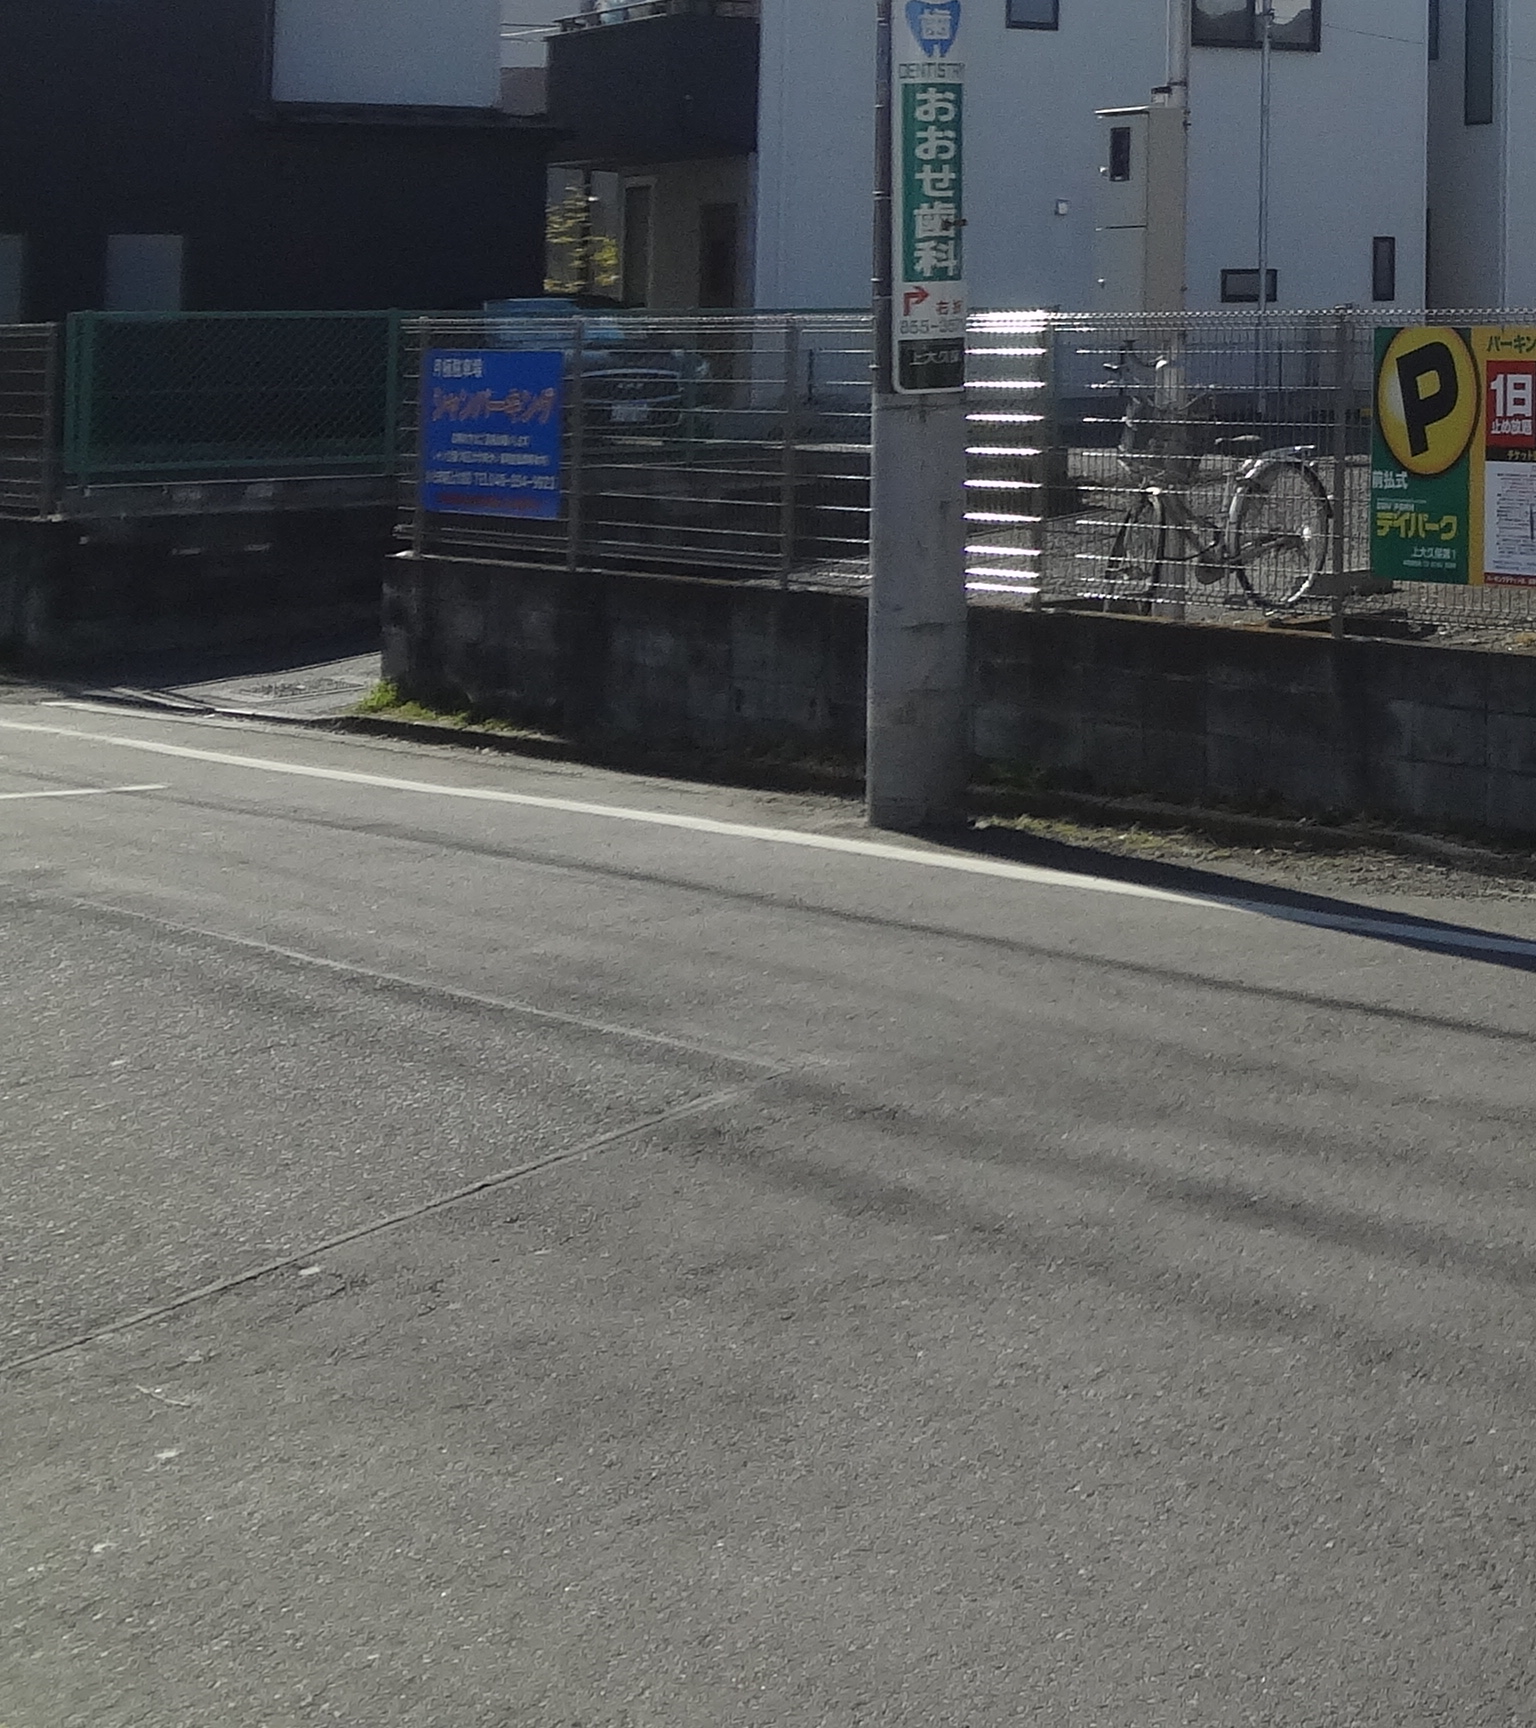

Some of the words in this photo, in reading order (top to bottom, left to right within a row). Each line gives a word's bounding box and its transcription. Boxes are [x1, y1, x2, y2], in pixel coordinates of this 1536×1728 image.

[914, 86, 957, 278] おおせ歯科
[1396, 341, 1458, 456] P
[1490, 373, 1534, 419] 1日
[1372, 469, 1409, 490] 前払式
[1376, 511, 1458, 541] デイパーク
